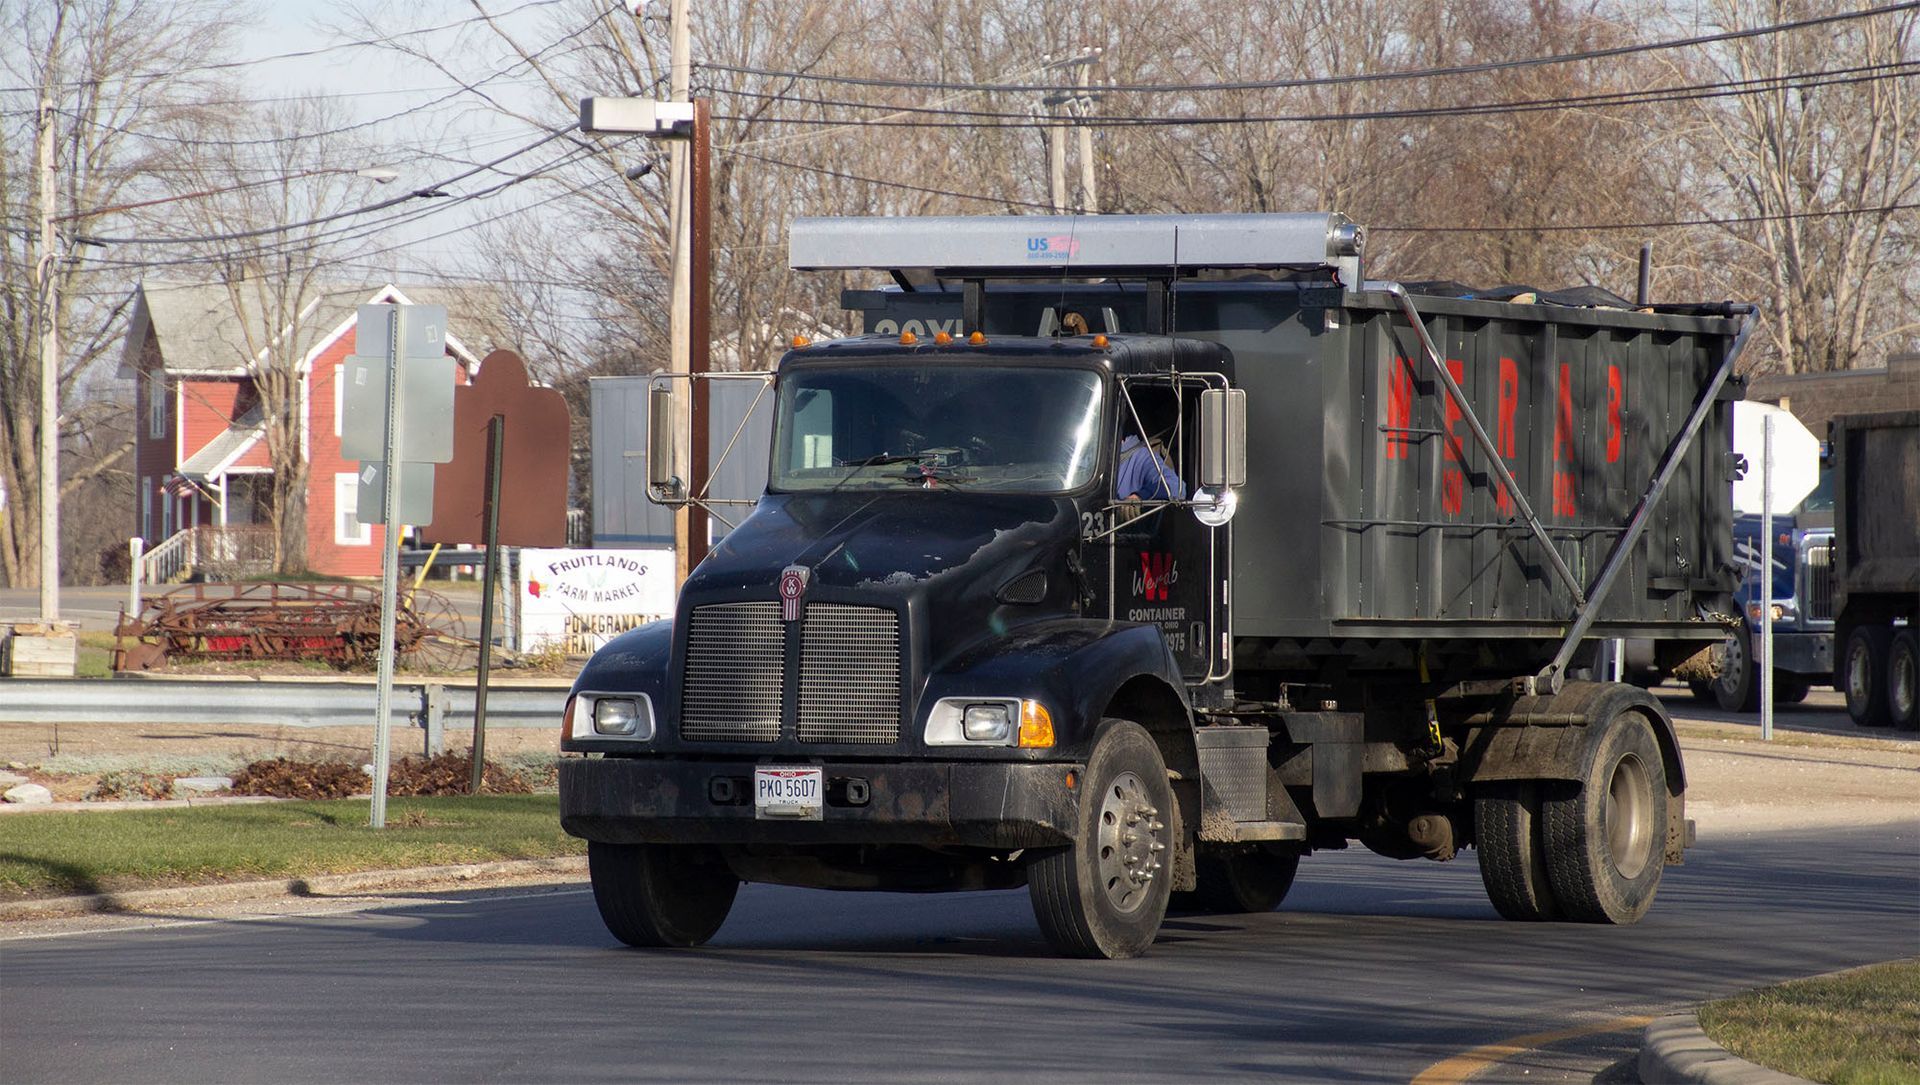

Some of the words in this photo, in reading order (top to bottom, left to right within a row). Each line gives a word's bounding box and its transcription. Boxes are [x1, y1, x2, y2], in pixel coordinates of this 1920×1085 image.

[1081, 511, 1105, 537] 23
[548, 555, 649, 576] FRUITLANDS
[556, 582, 588, 601] FARM
[593, 582, 640, 603] MARKET
[1128, 607, 1186, 622] CONTAINER
[1164, 621, 1180, 629] OHIO
[759, 779, 783, 798] PKQ
[786, 779, 816, 798] 5607
